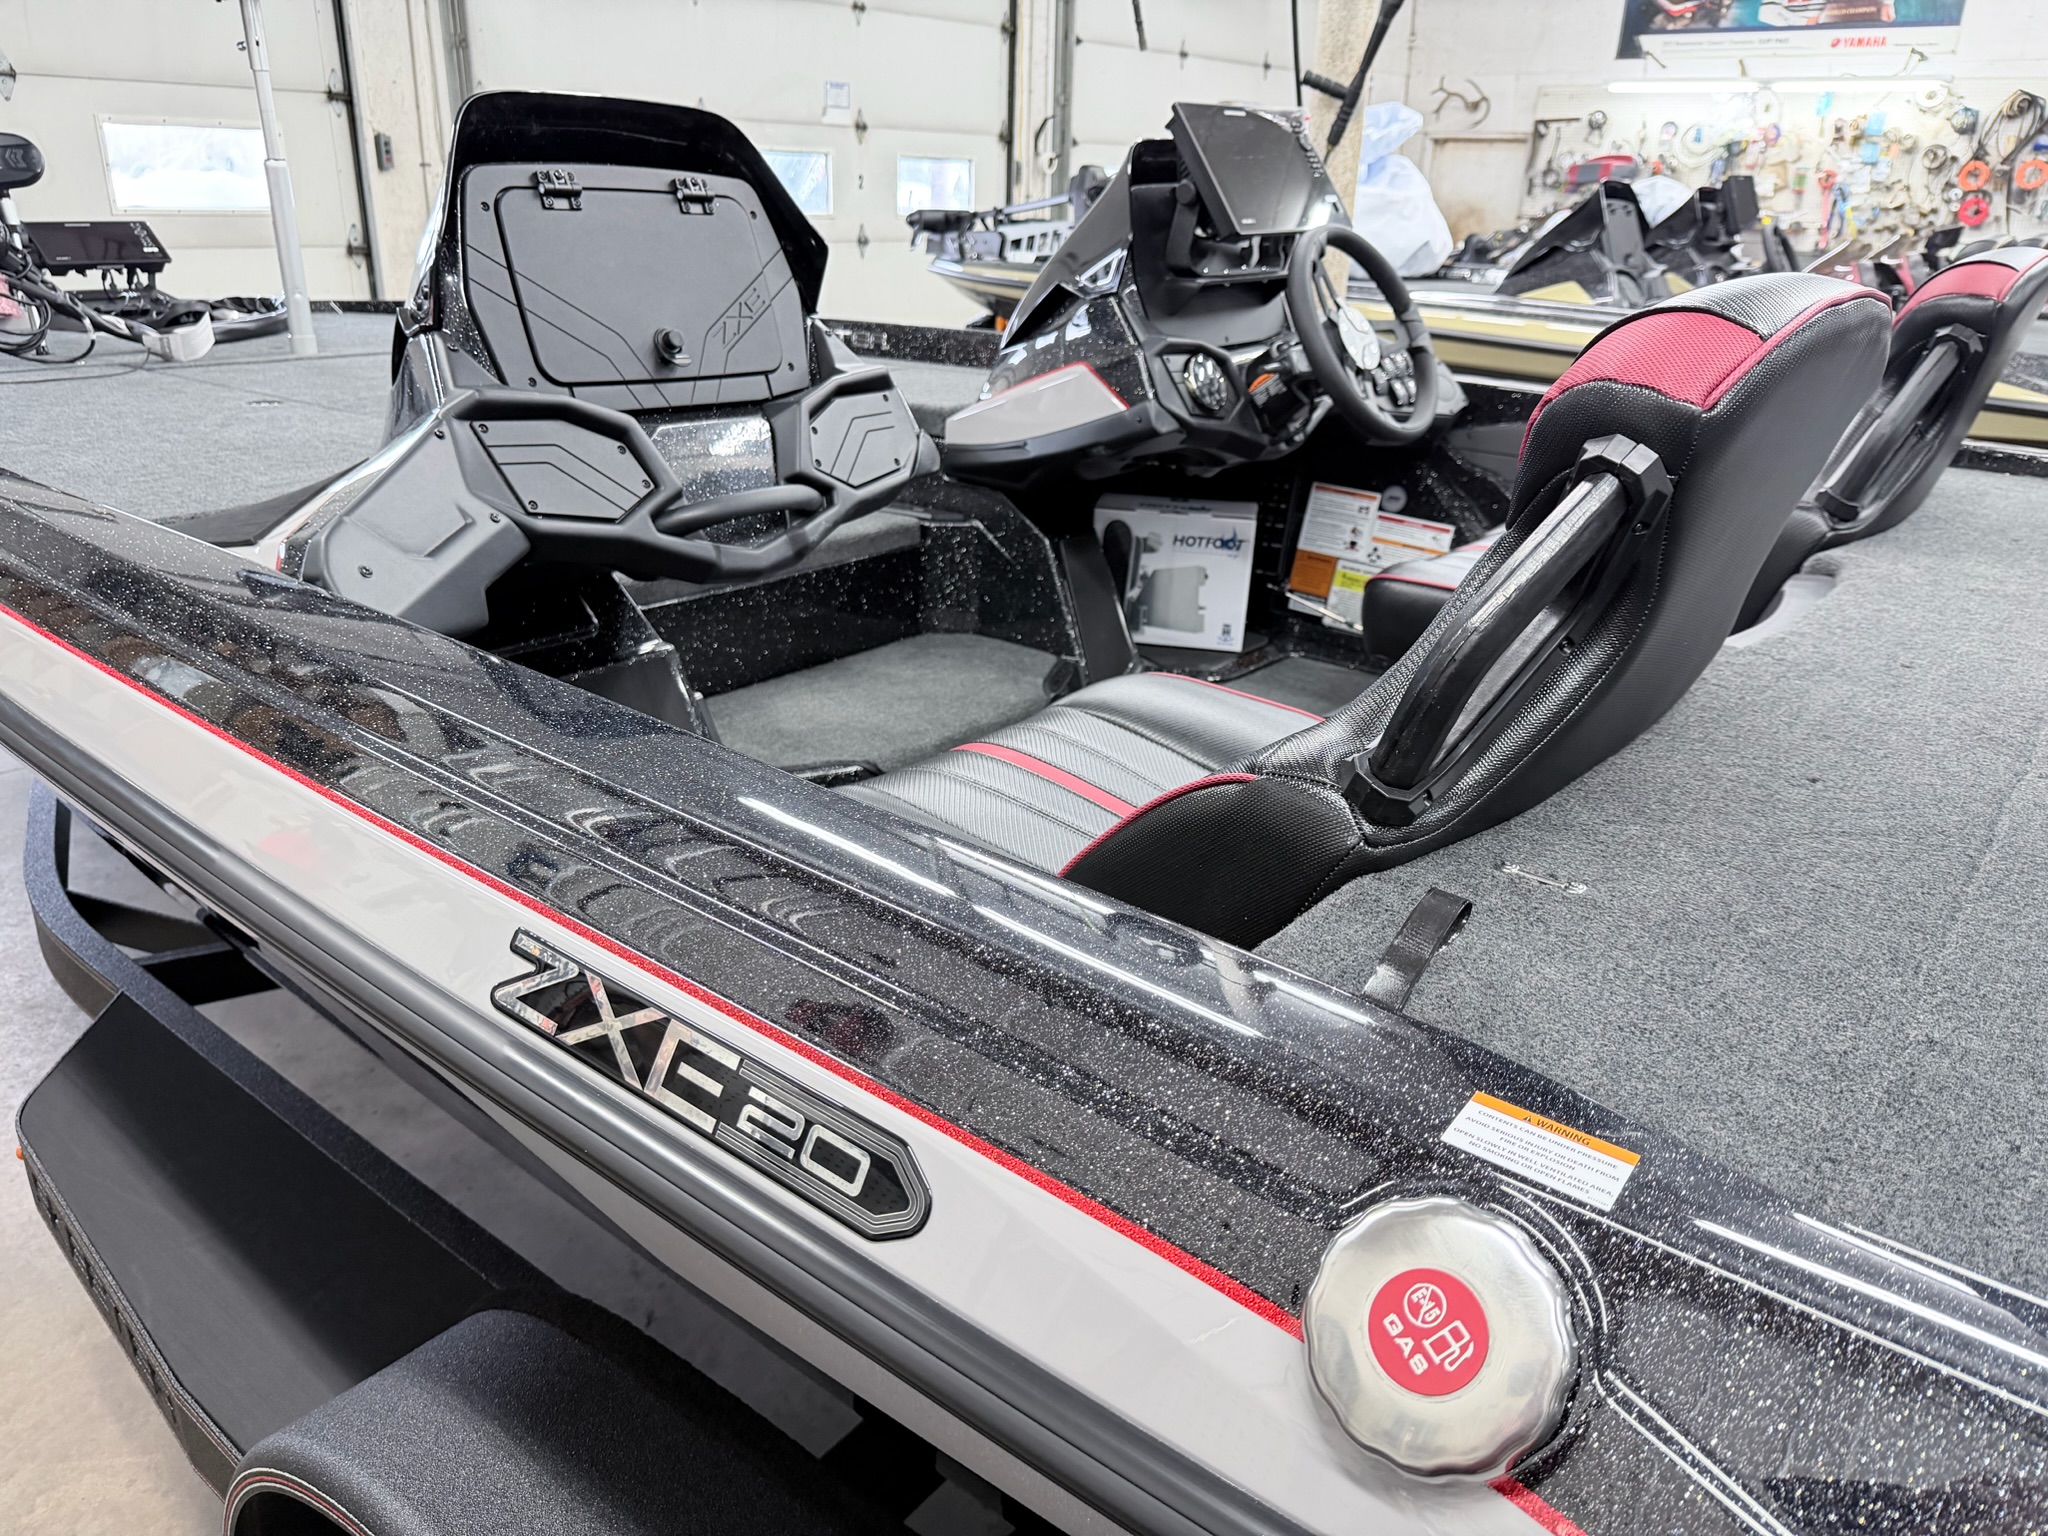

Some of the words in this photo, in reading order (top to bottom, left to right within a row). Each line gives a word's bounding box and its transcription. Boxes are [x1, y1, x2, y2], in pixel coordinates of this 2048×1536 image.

[1844, 36, 1888, 48] YAMAHA
[858, 174, 864, 190] 2
[712, 287, 766, 350] ZXE
[1172, 533, 1247, 551] HOTFOOT
[494, 933, 743, 1135] ZXE
[735, 1085, 872, 1198] 20
[1453, 1127, 1476, 1139] OPEN
[1476, 1136, 1508, 1152] SLOWLY
[1507, 1149, 1517, 1157] IN
[1517, 1153, 1538, 1166] WELL
[1539, 1162, 1589, 1187] VENTILATED
[1465, 1116, 1490, 1129] AVOID
[1491, 1126, 1523, 1143] SERIOUS
[1524, 1140, 1552, 1155] INJURY
[1554, 1151, 1567, 1161] OR
[1566, 1157, 1595, 1172] DEATH
[1594, 1169, 1620, 1183] FROM
[1478, 1110, 1519, 1129] CONTENTS
[1519, 1126, 1537, 1137] CAN
[1548, 1136, 1577, 1154] UNDER
[1576, 1150, 1618, 1170] PRESSURE
[1499, 1136, 1517, 1147] FIRE
[1517, 1143, 1530, 1153] OR
[1530, 1148, 1576, 1171] EXPLOSION
[1537, 1118, 1592, 1146] WARNING
[1468, 1140, 1482, 1149] NO
[1481, 1144, 1520, 1165] SMOKING
[1520, 1162, 1533, 1171] OR
[1533, 1166, 1557, 1180] OPEN
[1556, 1177, 1590, 1195] FLAMES
[1382, 1312, 1429, 1376] GAS
